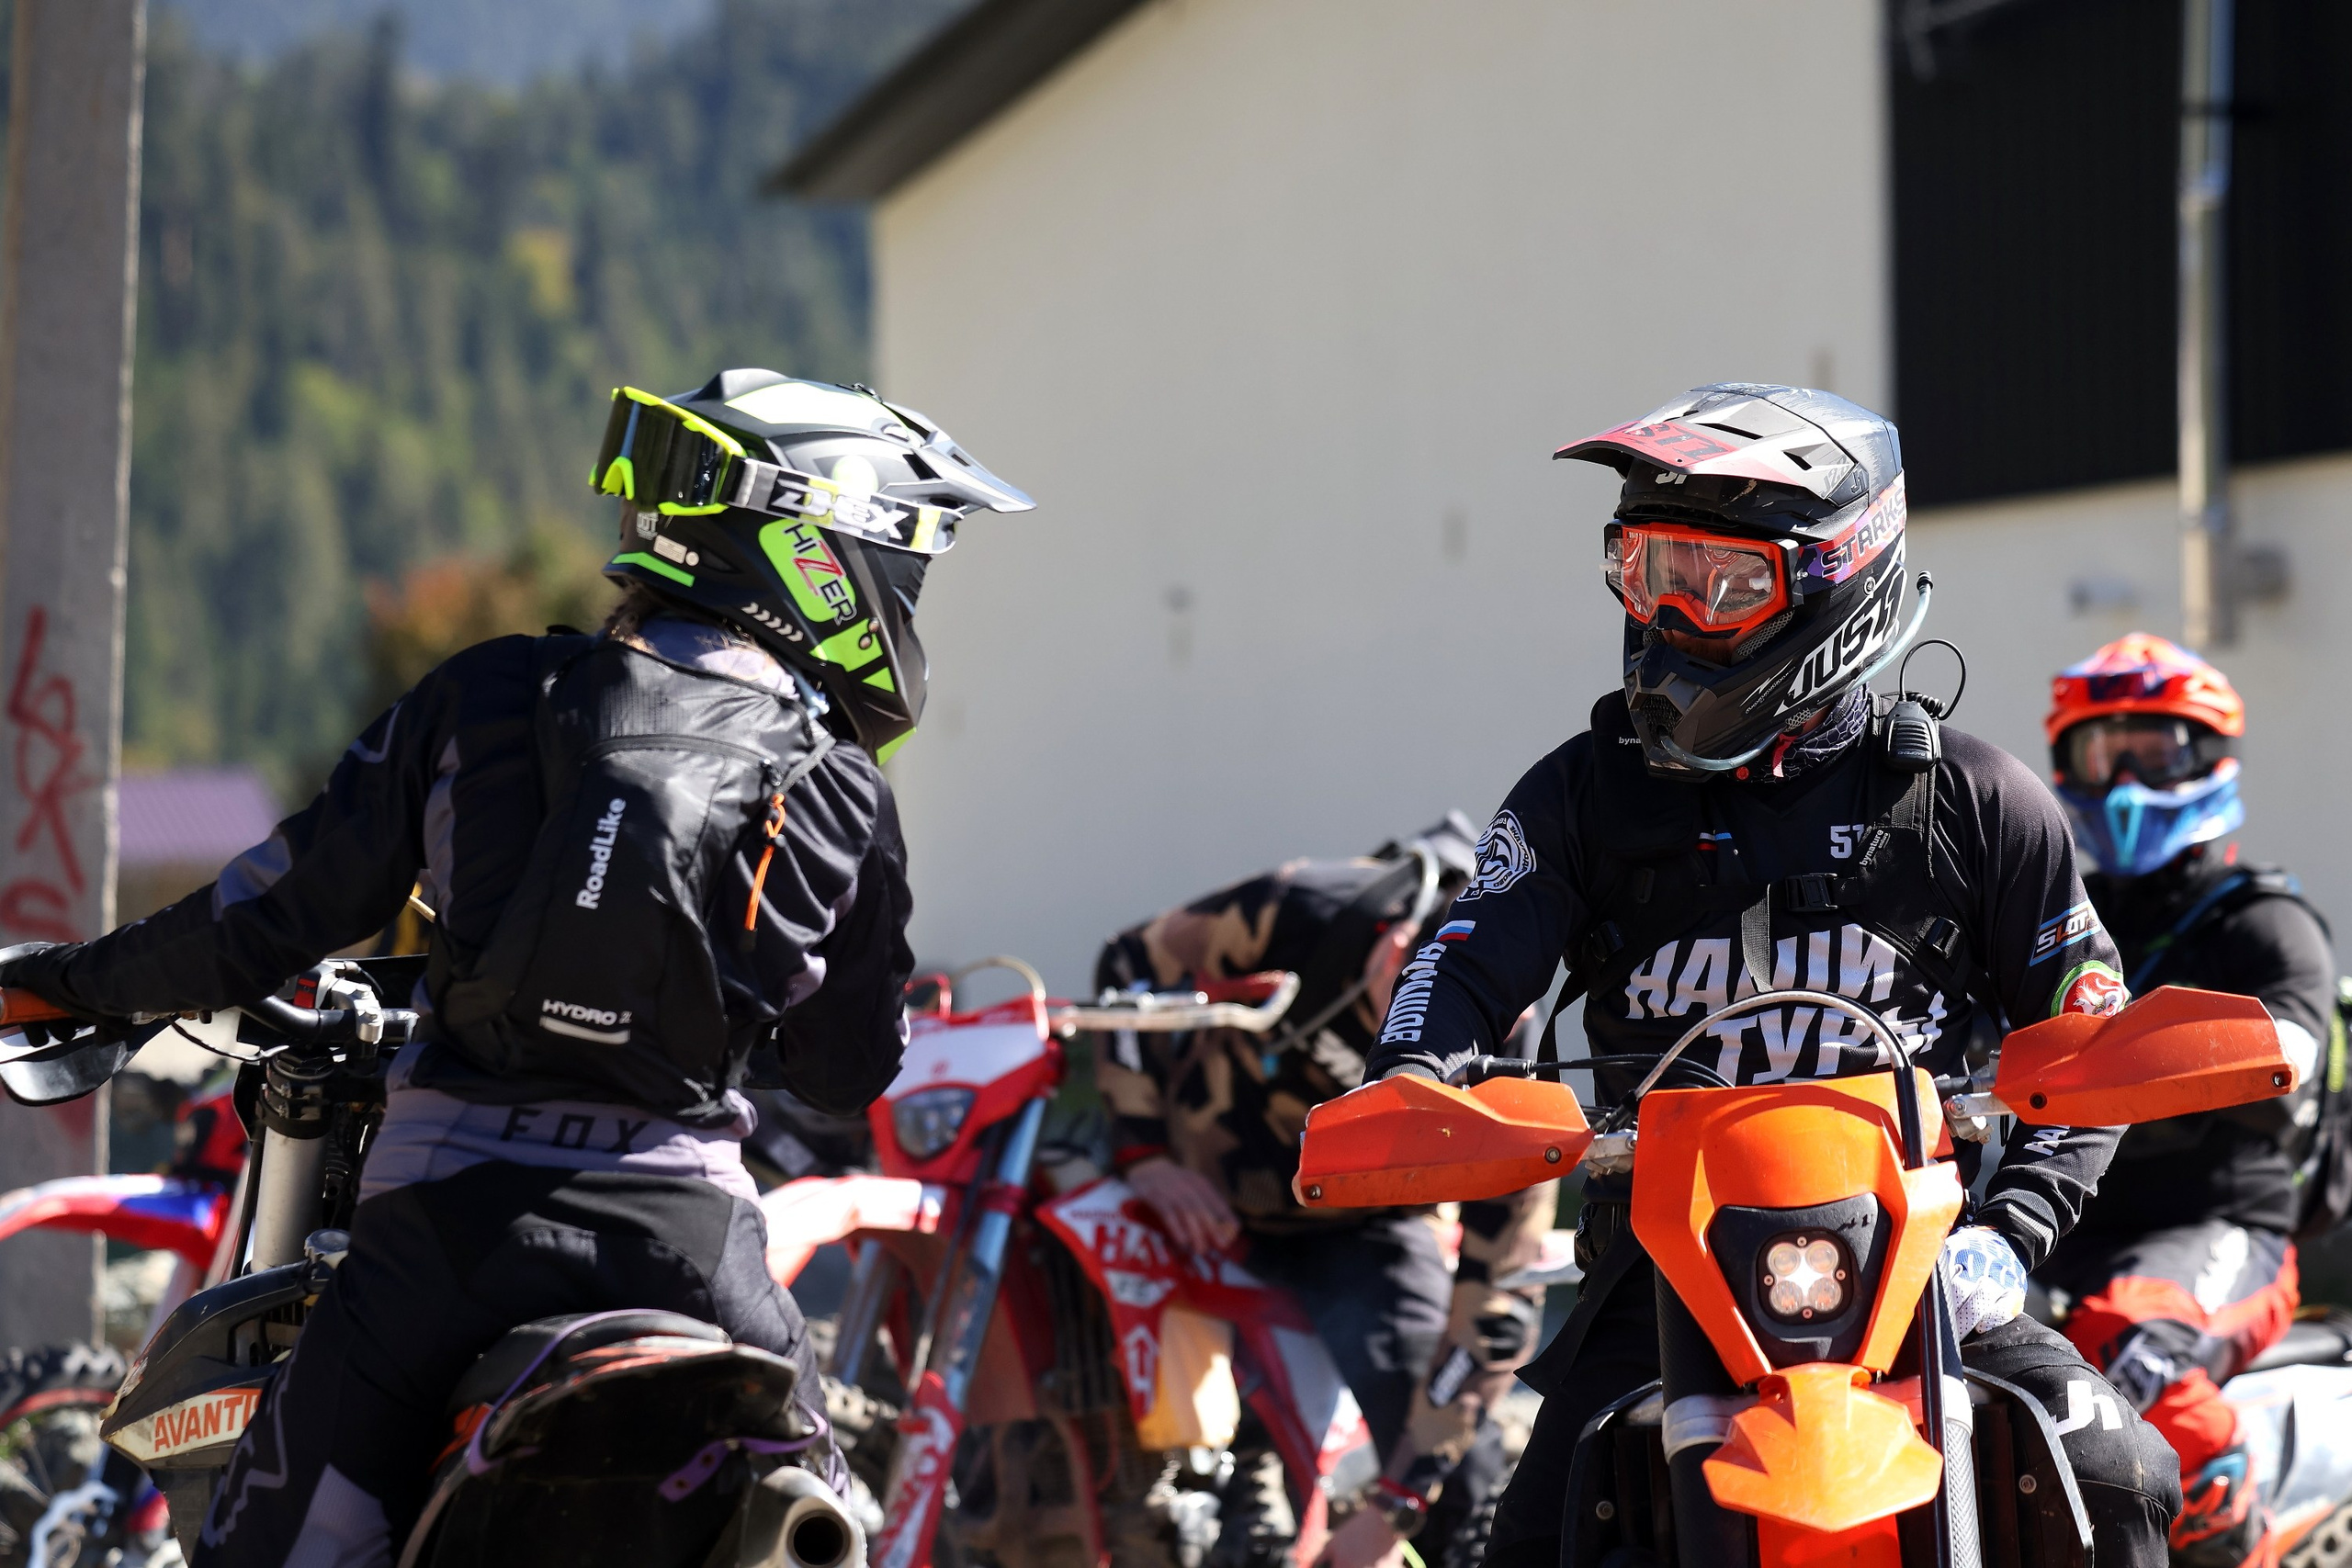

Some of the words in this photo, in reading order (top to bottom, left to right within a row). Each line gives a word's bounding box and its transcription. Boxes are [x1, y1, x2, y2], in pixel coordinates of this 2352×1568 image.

[784, 523, 858, 626] HIZER
[1618, 736, 1642, 745] byna
[575, 797, 627, 910] RoadLike
[1859, 829, 1884, 866] bynature
[542, 998, 618, 1026] HYDRO
[500, 1106, 650, 1154] FOX
[154, 1394, 260, 1452] AVANTI
